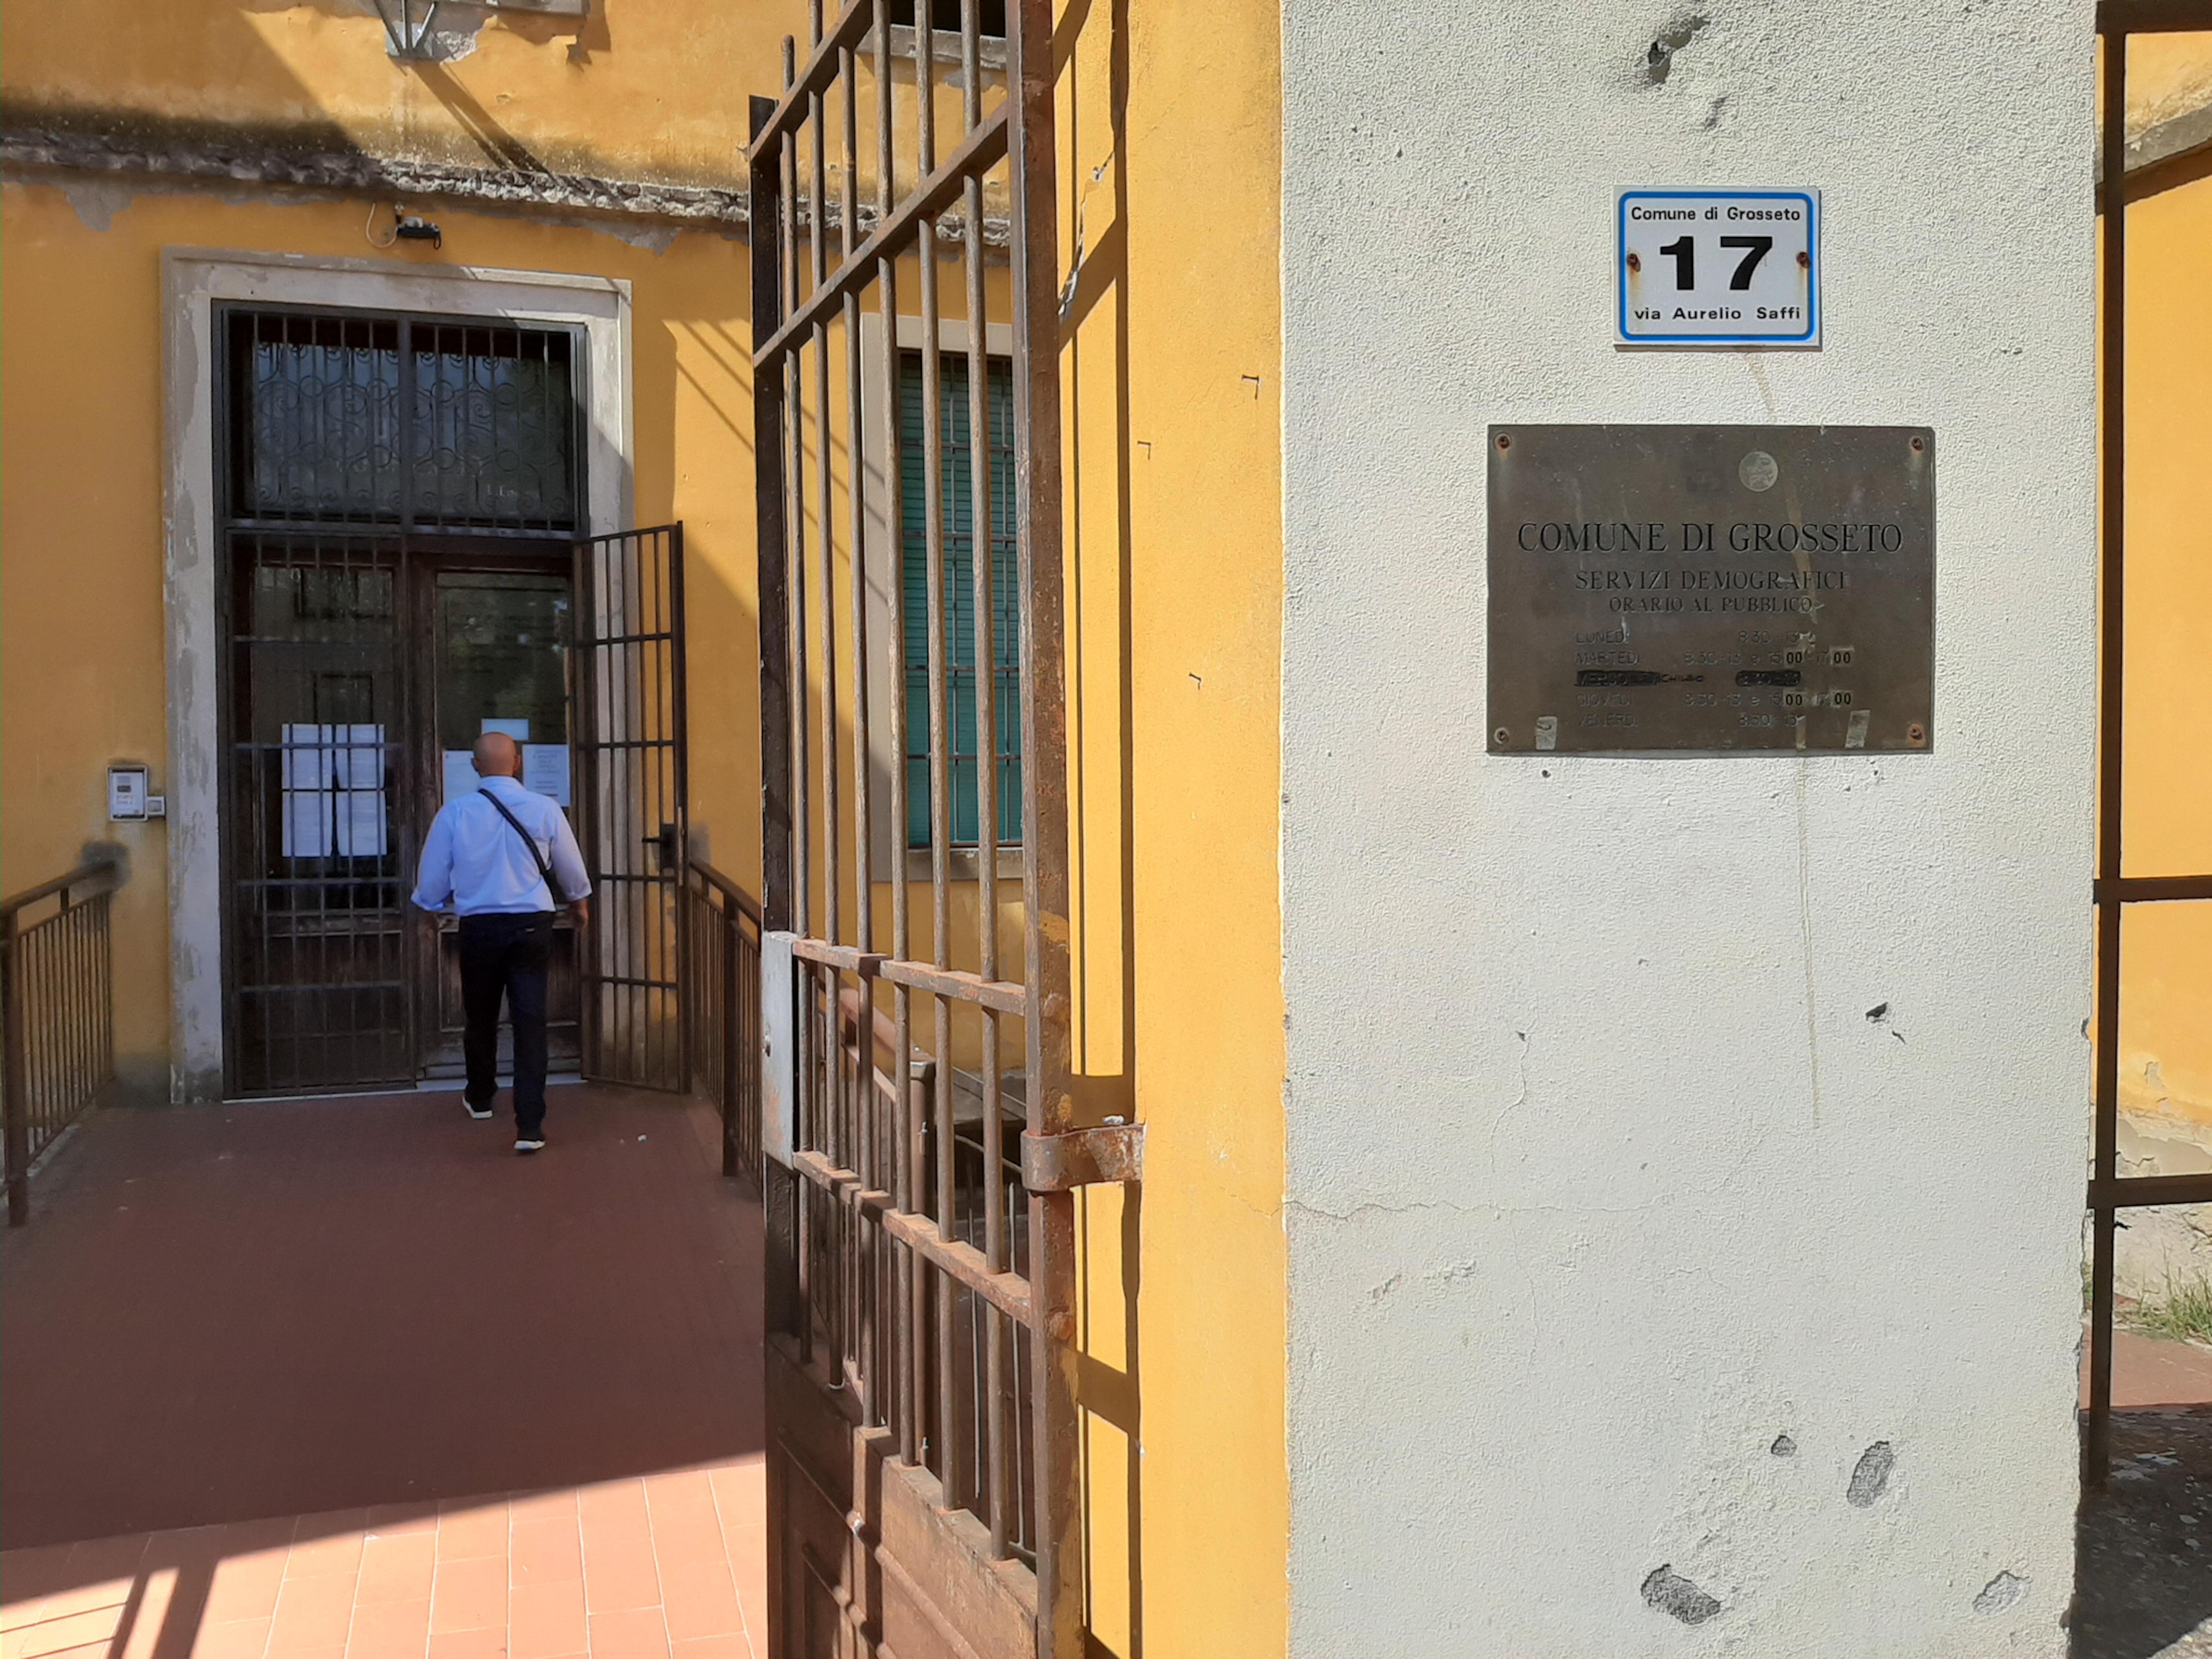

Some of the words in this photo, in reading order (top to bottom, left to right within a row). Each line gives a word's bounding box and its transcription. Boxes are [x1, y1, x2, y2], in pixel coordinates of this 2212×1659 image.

[1631, 206, 1696, 220] Comune
[1704, 206, 1718, 220] di
[1727, 206, 1801, 220] Grosseto
[1660, 236, 1773, 291] 17
[1634, 307, 1661, 320] via
[1672, 307, 1742, 320] Aurelio
[1756, 307, 1801, 320] Saffi
[1518, 522, 1667, 552] COMUNE
[1681, 523, 1715, 552] DI
[1729, 523, 1903, 552] GROSSETO
[1575, 570, 1670, 590] SERVIZI
[1681, 570, 1846, 590] DEMOGRAFICI
[1609, 597, 1683, 612] ORARIO
[1692, 597, 1714, 612] AL
[1721, 597, 1812, 612] PUBBLICO
